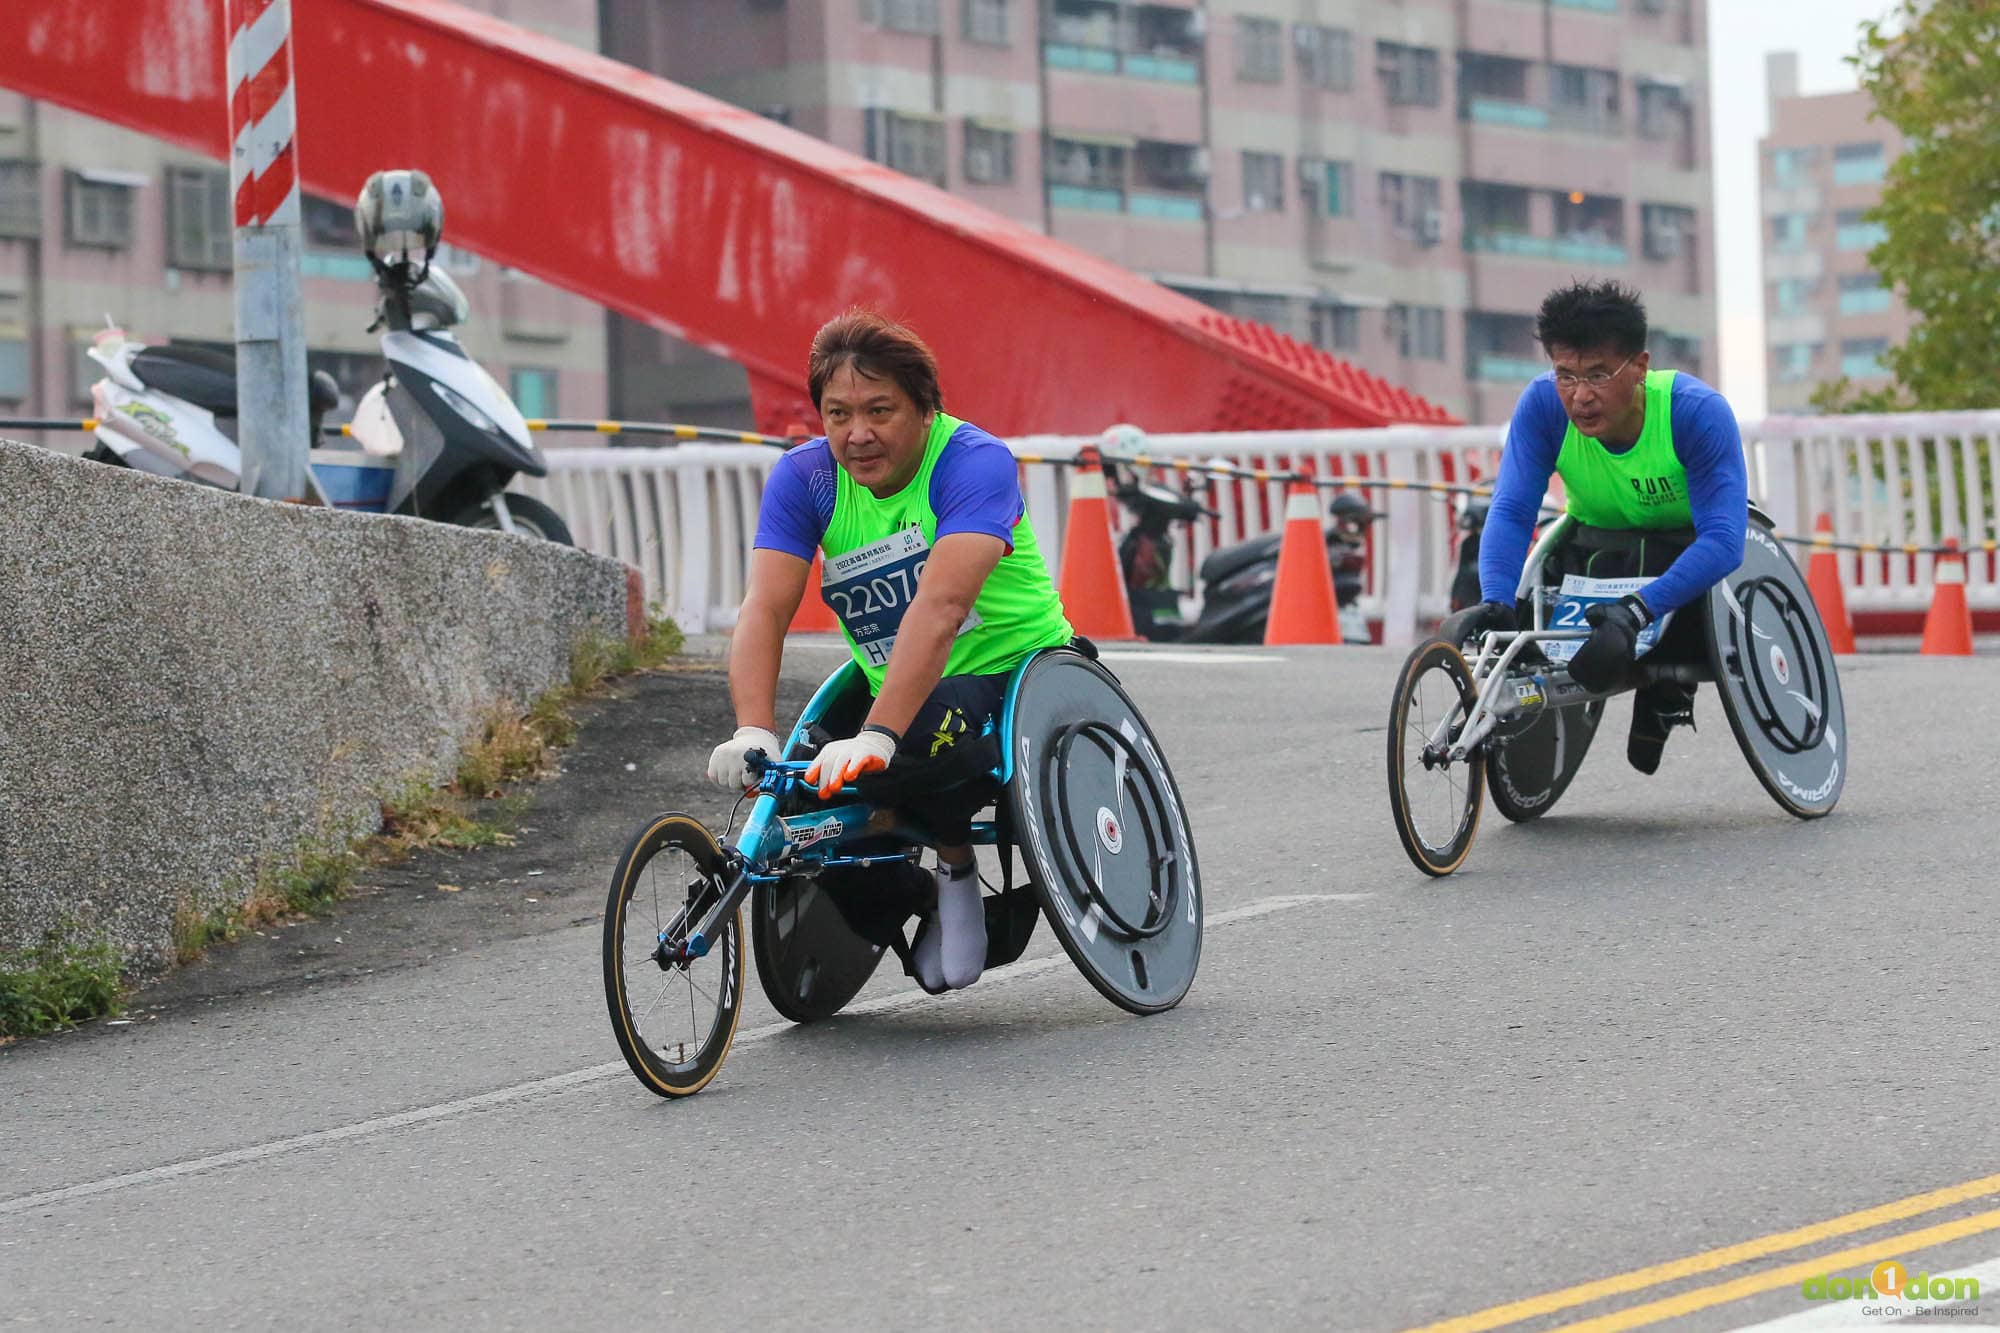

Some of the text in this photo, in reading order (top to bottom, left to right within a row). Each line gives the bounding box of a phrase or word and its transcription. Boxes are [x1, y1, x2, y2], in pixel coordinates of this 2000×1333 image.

[1631, 476, 1672, 494] RUN
[1745, 528, 1779, 558] IMA
[865, 642, 886, 664] H
[1778, 759, 1839, 801] CORIMA
[1021, 736, 1076, 927] CORIMA
[1141, 736, 1196, 925] CORIMA
